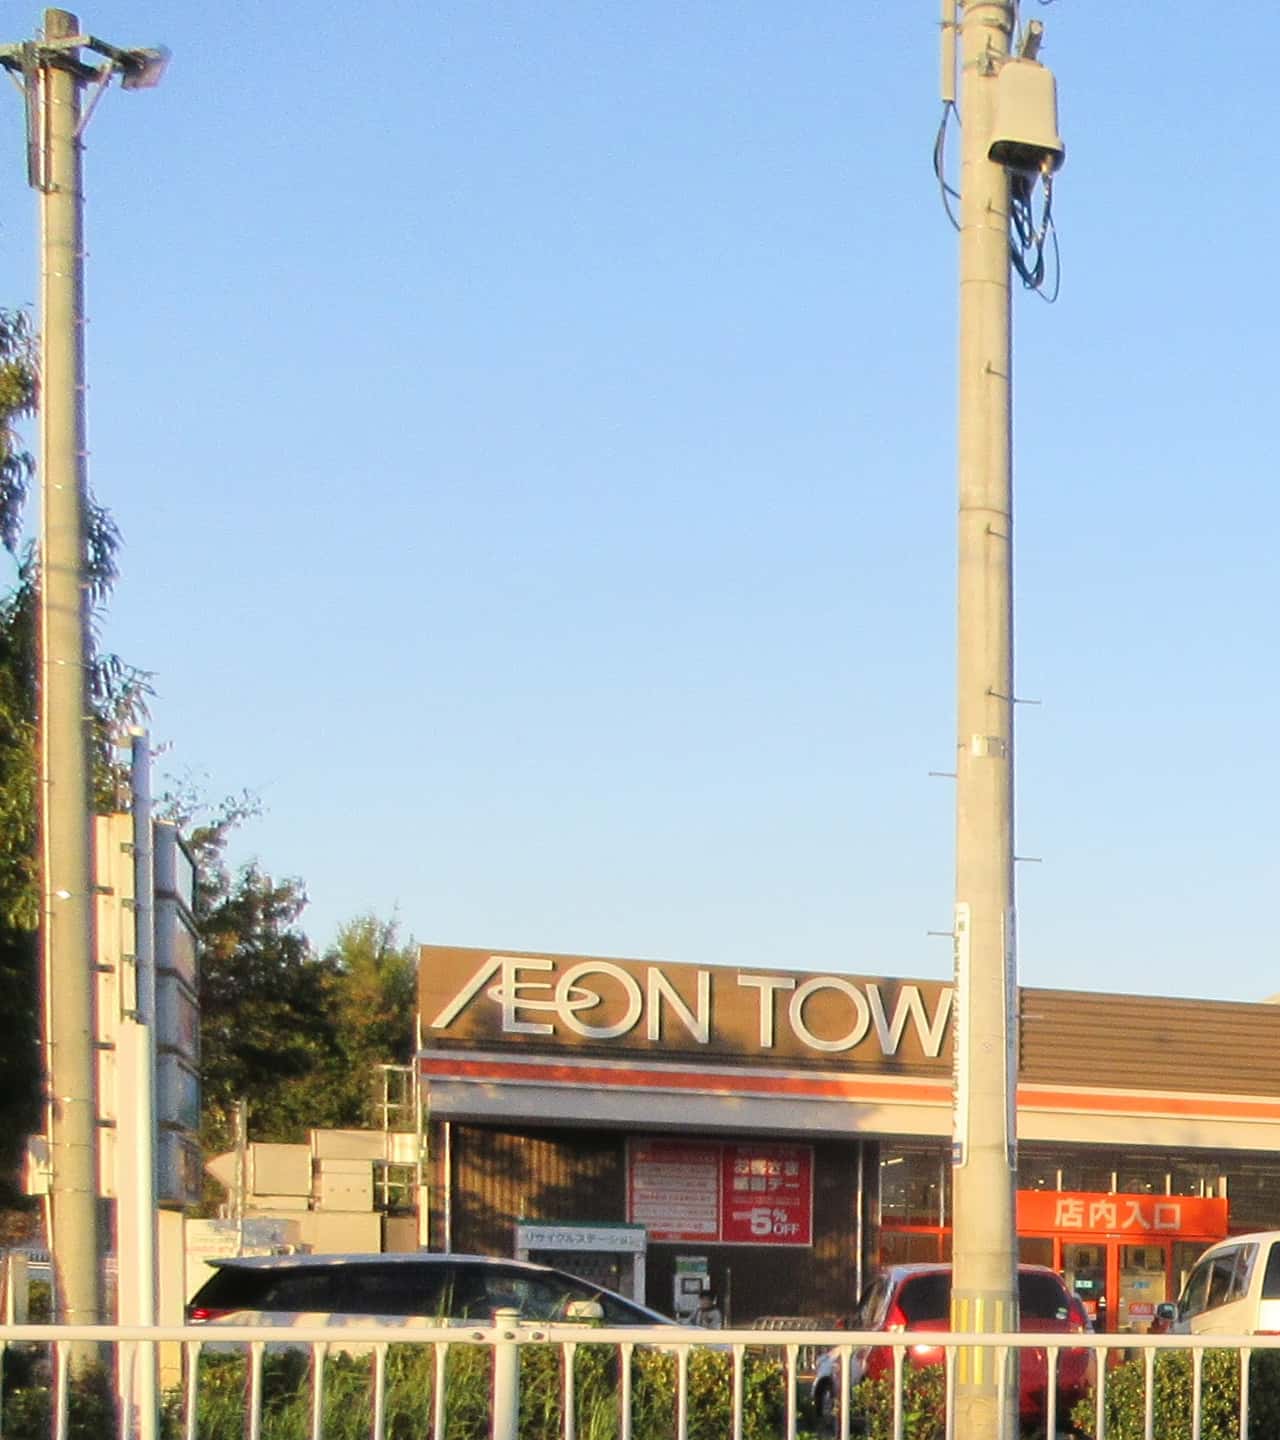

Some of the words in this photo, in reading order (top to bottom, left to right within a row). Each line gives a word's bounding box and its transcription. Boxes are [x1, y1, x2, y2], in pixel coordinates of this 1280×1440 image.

[737, 968, 954, 1058] TOW
[1055, 1197, 1182, 1230] 店内入口
